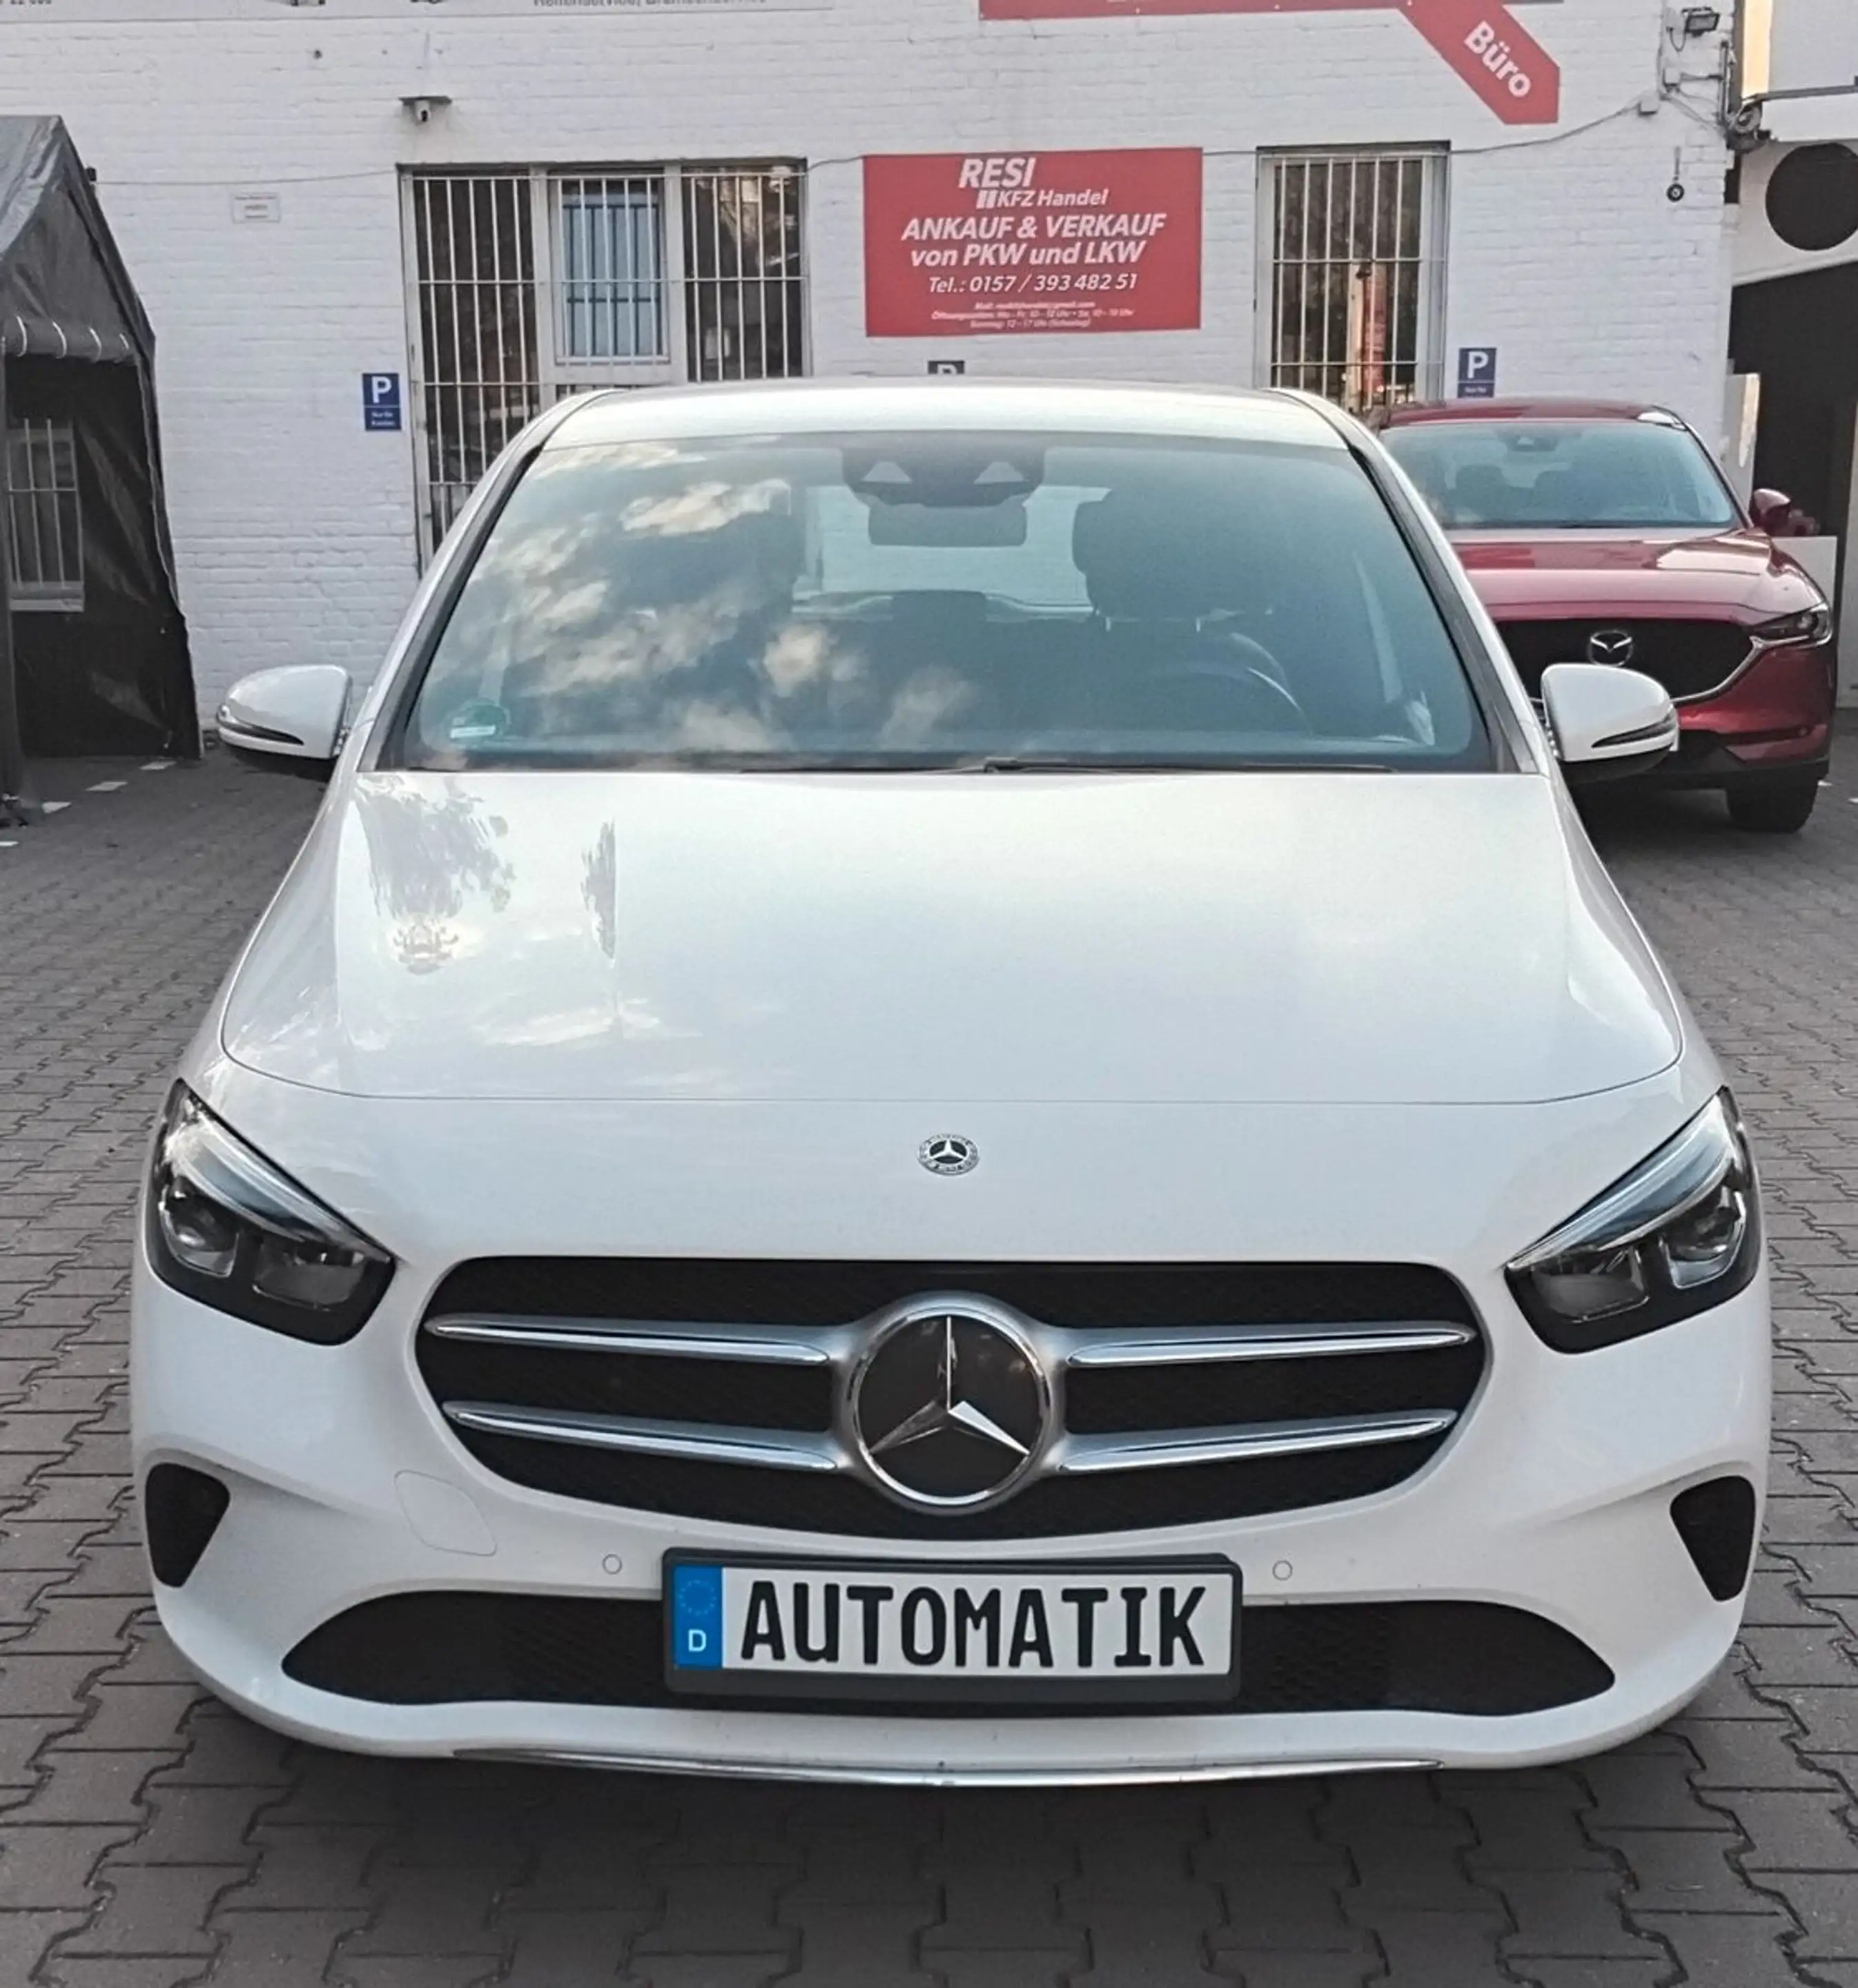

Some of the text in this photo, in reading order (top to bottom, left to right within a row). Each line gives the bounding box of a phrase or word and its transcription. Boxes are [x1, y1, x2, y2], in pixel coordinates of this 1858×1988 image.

[1463, 19, 1532, 97] Büro
[959, 157, 1036, 189] RESI
[997, 189, 1109, 207] KFZ Handel
[901, 213, 1167, 241] ANKAUF & VERKAUF
[910, 240, 1147, 267] von PKW und LKW
[929, 273, 1137, 293] Tel.: 0157 / 393 482 51
[1467, 351, 1489, 379] P
[371, 376, 392, 404] P
[740, 1580, 1206, 1668] AUTOMATIK
[687, 1629, 707, 1652] D
